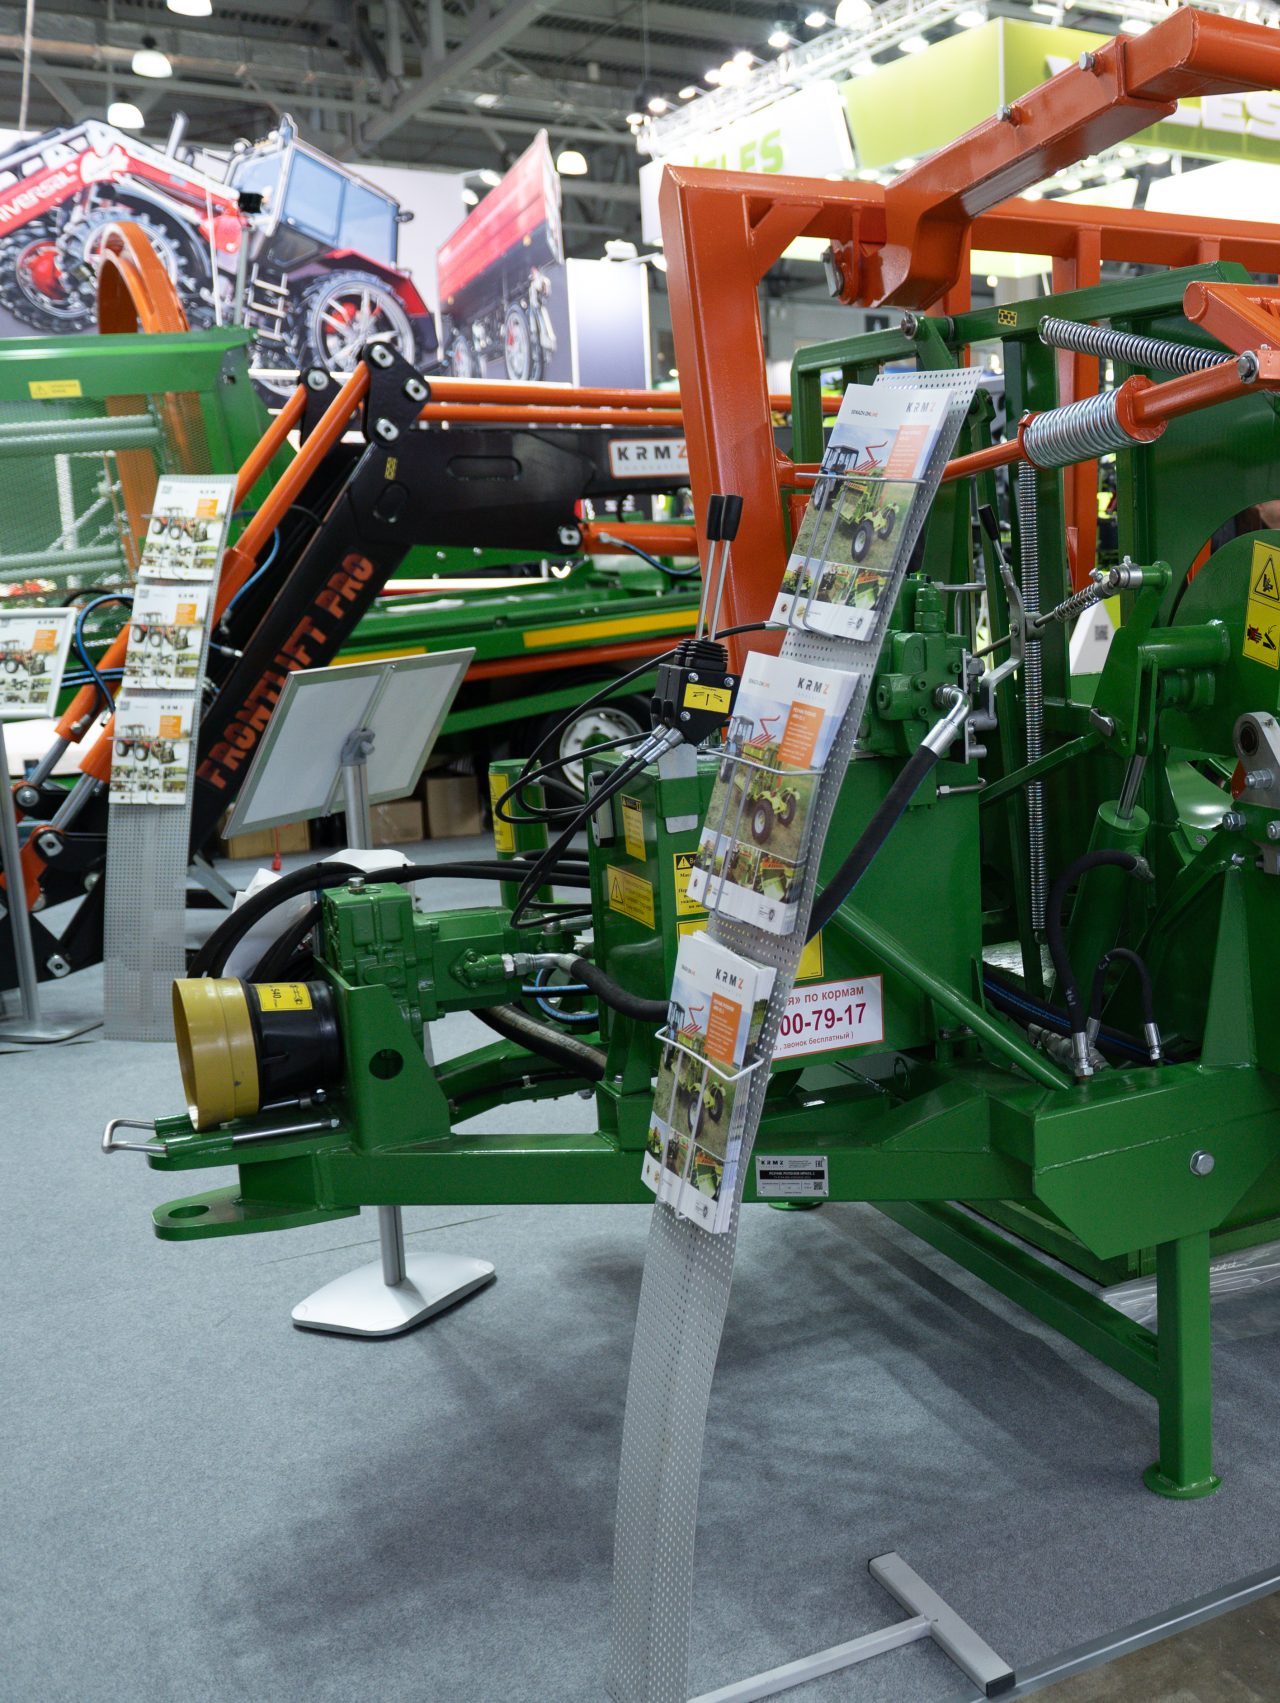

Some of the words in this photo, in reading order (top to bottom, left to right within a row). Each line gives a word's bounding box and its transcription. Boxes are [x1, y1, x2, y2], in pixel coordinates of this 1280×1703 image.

[315, 552, 374, 620] PRO
[797, 677, 831, 695] KRMZ
[715, 968, 744, 990] KRMZ
[804, 992, 819, 1003] по
[821, 985, 864, 1001] кормам
[780, 1002, 867, 1036] 00-79-17
[783, 1038, 808, 1050] звонок
[808, 1032, 850, 1045] бесплатный
